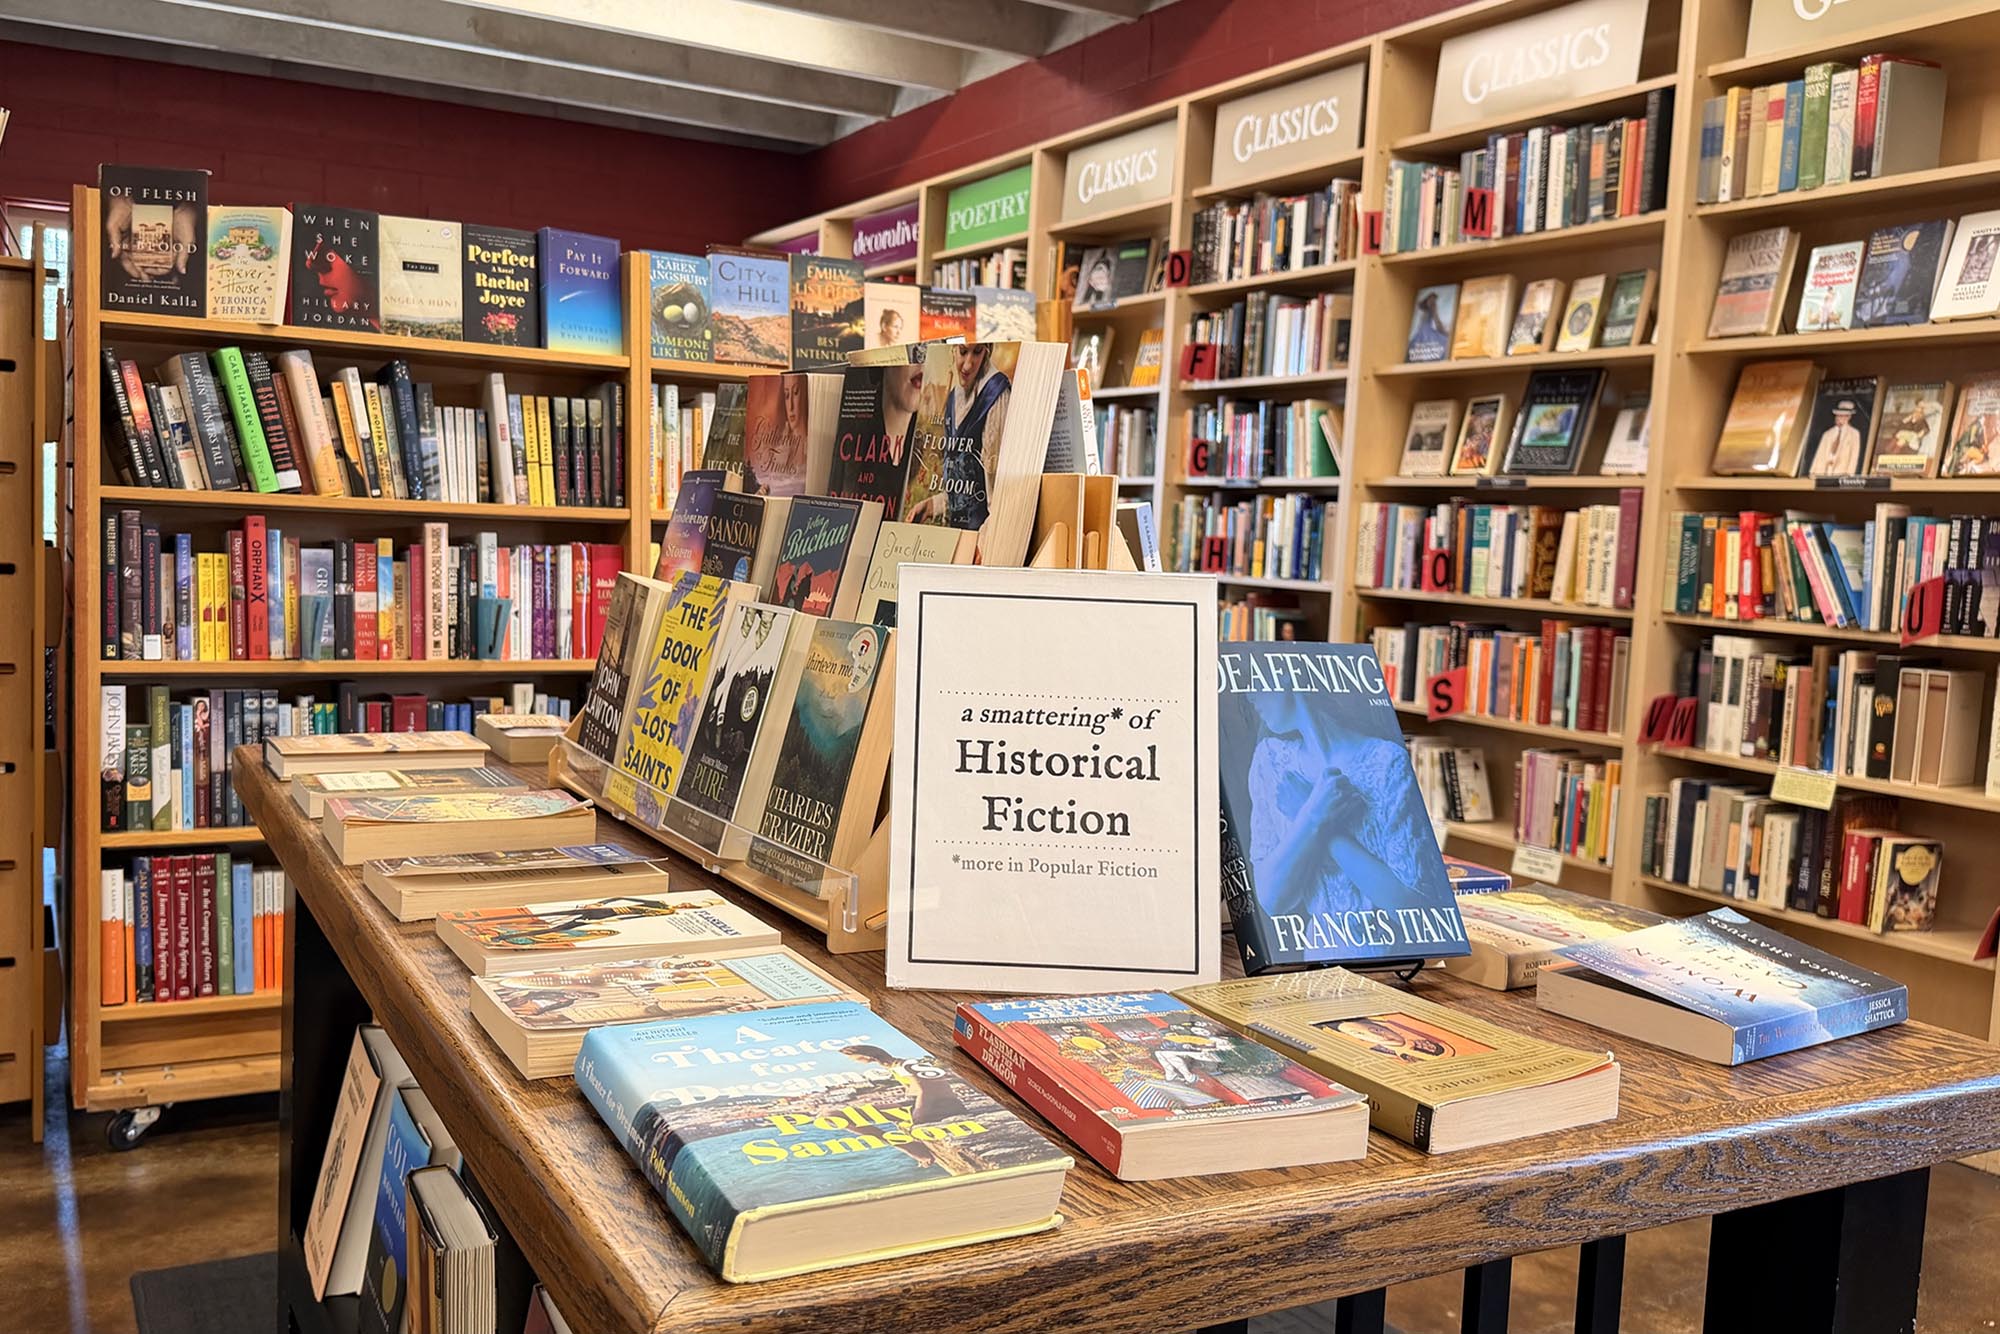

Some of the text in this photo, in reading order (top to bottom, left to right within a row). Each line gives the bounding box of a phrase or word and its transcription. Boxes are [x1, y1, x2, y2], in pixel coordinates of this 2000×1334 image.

[1461, 23, 1611, 104] CLASSICS
[1233, 96, 1339, 163] CLASSICS
[1077, 148, 1157, 204] CLASSICS
[110, 186, 197, 201] OF FLESH
[303, 214, 370, 231] WHEN
[949, 190, 1029, 234] POETRY
[1463, 192, 1487, 231] M
[137, 242, 197, 254] BLOOD
[316, 233, 357, 247] SHE
[1370, 215, 1380, 250] L
[217, 263, 265, 279] Forever
[305, 250, 368, 266] WOKE
[468, 244, 536, 269] Perfect
[560, 263, 610, 280] FORWARD
[656, 259, 697, 274] KAREN
[718, 261, 768, 283] CITY
[1170, 254, 1185, 283] D
[222, 281, 259, 294] House
[475, 273, 529, 292] Rachel
[807, 266, 850, 282] EMILY
[109, 293, 198, 307] Daniel Kalla
[214, 295, 267, 305] VERONICA
[222, 306, 257, 314] HENRY
[303, 297, 370, 311] HILLARY
[384, 296, 459, 309] ANGELA HUNT
[479, 290, 525, 308] Joyce
[739, 285, 780, 304] HILL
[303, 313, 370, 326] JORDAN
[922, 305, 972, 319] Sue Monk
[651, 336, 710, 351] SOMEONE
[652, 348, 708, 361] LIKE YOU
[817, 336, 840, 347] BEST
[1190, 346, 1207, 375] F
[110, 369, 120, 382] INTO
[116, 393, 129, 414] FOREST
[228, 354, 254, 427] CARL HIAASEN
[256, 386, 281, 421] OSCAR
[188, 356, 207, 395] HELPRIN
[211, 444, 224, 466] TALE
[369, 389, 384, 453] ALICE HOFFMAN
[727, 434, 741, 446] THE
[839, 433, 904, 463] CLARK
[923, 433, 974, 453] FLOWER
[1193, 442, 1208, 473] G
[857, 472, 875, 484] AND
[929, 474, 974, 495] BLOOM
[431, 527, 441, 555] SHINING
[708, 516, 758, 548] SANSOM
[782, 522, 849, 562] Buchan
[233, 537, 243, 583] Days Light
[357, 547, 366, 587] IRVING
[665, 543, 692, 560] Storm
[1208, 538, 1225, 567] H
[251, 540, 265, 603] ORPHAN X
[367, 552, 377, 583] JOHN
[431, 556, 441, 590] THROUGH
[1432, 552, 1450, 587] O
[431, 592, 441, 614] SUSAN
[448, 568, 458, 625] BERLIN STORIES
[1907, 585, 1925, 634] U
[680, 601, 709, 632] THE
[661, 637, 702, 672] BOOK
[806, 651, 838, 676] thirteen
[595, 663, 621, 698] JOHN
[661, 681, 682, 705] OF
[1432, 678, 1453, 713] S
[157, 695, 166, 742] Benevolence
[585, 688, 622, 736] LAWTON
[961, 707, 973, 722] a
[1129, 709, 1161, 730] of
[1647, 700, 1666, 737] V
[1671, 706, 1694, 740] W
[104, 692, 121, 768] JOHN JAKES
[586, 720, 610, 749] SECOND
[641, 712, 678, 747] LOST
[129, 749, 139, 775] JAKES
[139, 747, 149, 774] JOHN
[624, 746, 673, 791] SAINTS
[955, 739, 1161, 781] Historical
[690, 763, 728, 802] PURE
[767, 787, 834, 830] CHARLES
[982, 795, 1131, 836] Fiction
[761, 812, 827, 859] FRAZIER
[1008, 856, 1023, 872] in
[1028, 858, 1093, 878] Popular
[1098, 860, 1158, 878] Fiction
[138, 869, 149, 929] JAN KARON
[201, 910, 211, 946] Company
[1271, 907, 1465, 953] FRANCES ITANI
[1525, 959, 1553, 969] ROBERT
[1706, 917, 1872, 989] JESSICA SHATTUCK
[1864, 1008, 1896, 1025] SHATTUCK
[1868, 997, 1892, 1013] JESSICA
[736, 1025, 776, 1045] A
[979, 1024, 1026, 1071] FLASHMAN
[651, 1033, 872, 1069] Theater
[989, 1046, 1013, 1071] AND THE
[1507, 1055, 1576, 1076] ORCHID
[649, 1059, 946, 1106] Dreamers
[750, 1060, 818, 1078] for
[982, 1049, 1017, 1087] DRAGON
[580, 1056, 648, 1152] A Theater for Dreamers
[1027, 1076, 1042, 1095] GEORGE
[1060, 1104, 1077, 1122] FRASER
[766, 1102, 914, 1137] Polly
[741, 1119, 988, 1166] Samson
[649, 1147, 695, 1219] Polly Samson
